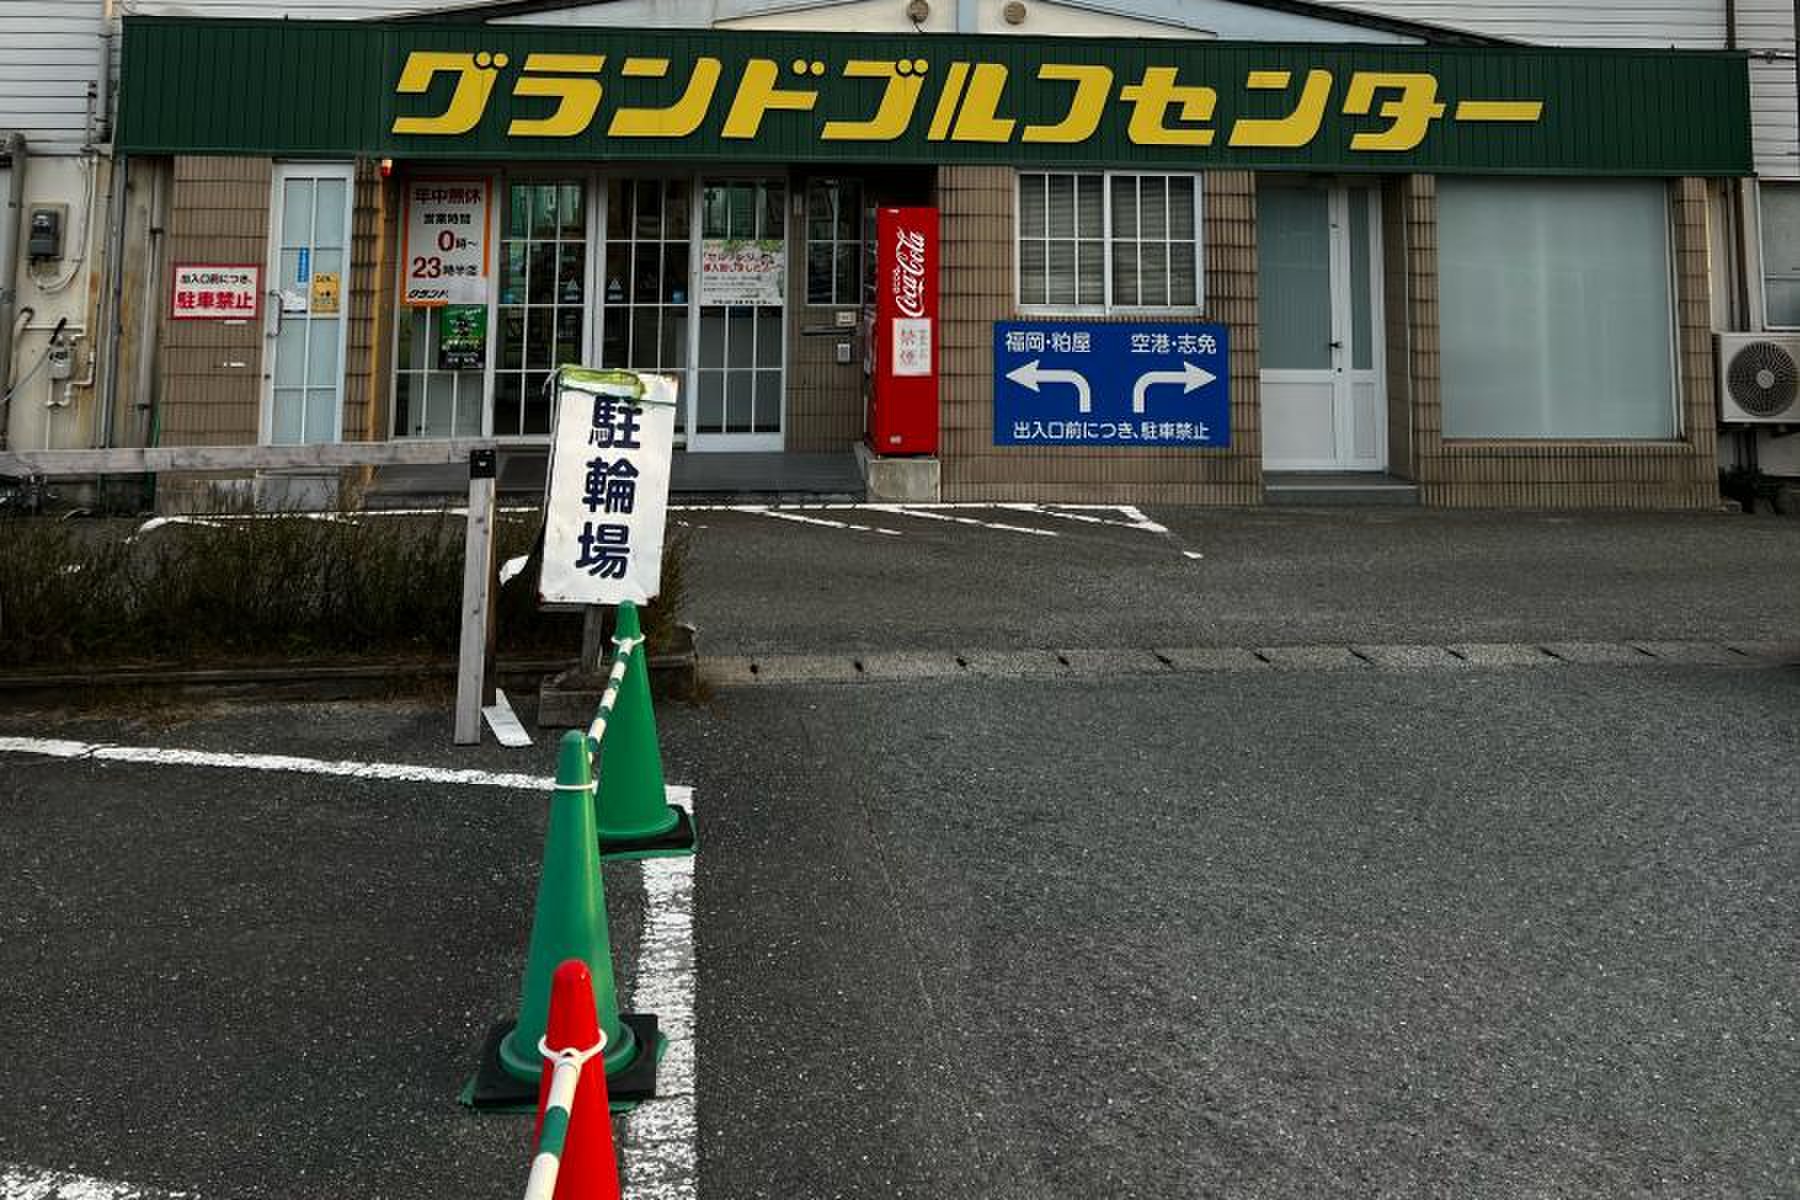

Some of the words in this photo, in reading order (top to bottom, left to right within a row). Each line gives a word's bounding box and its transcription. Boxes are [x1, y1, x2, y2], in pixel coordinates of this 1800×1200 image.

[391, 50, 1544, 151] グランドゴルフセンター
[895, 226, 926, 318] Coca-Cola
[176, 290, 254, 309] 駐車禁止
[1005, 331, 1091, 352] 福岡・粕屋
[1130, 333, 1217, 354] 空港・志免
[1013, 421, 1211, 440] 出入口前につき、駐車禁止
[575, 394, 643, 580] 駐輪場
